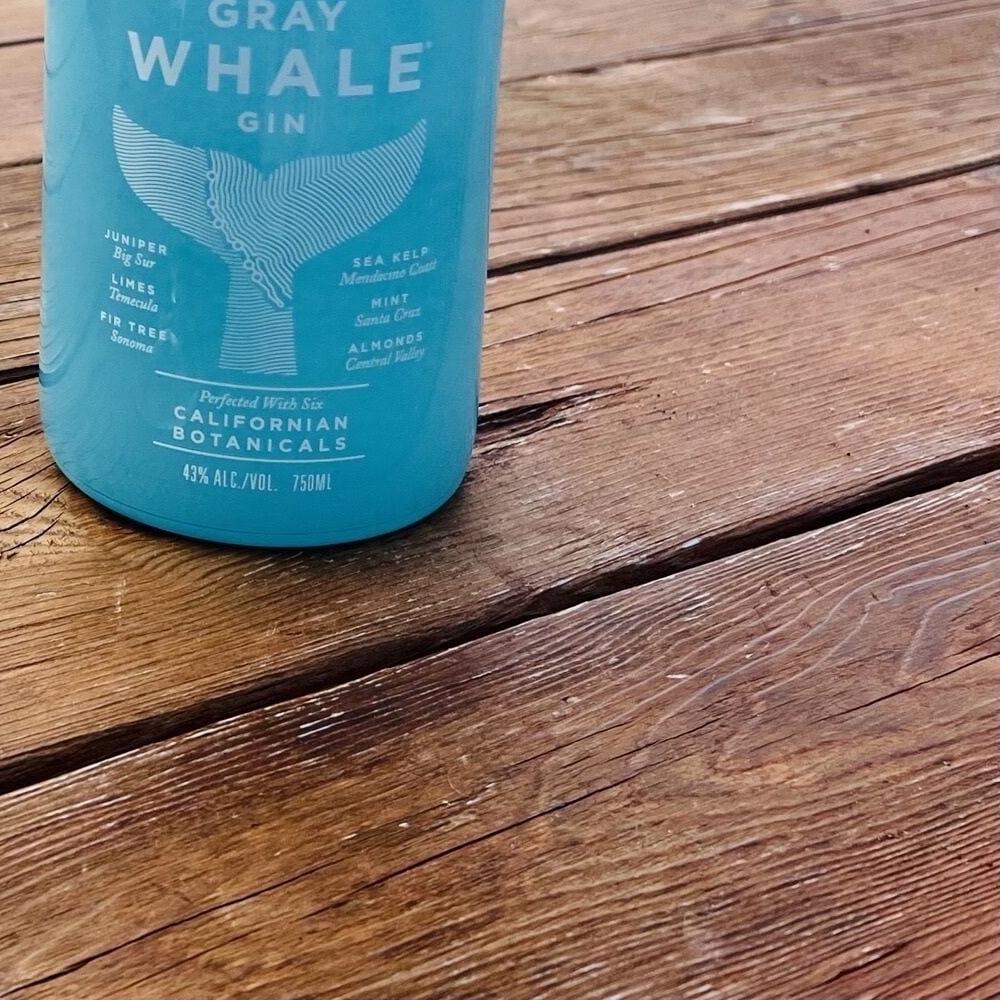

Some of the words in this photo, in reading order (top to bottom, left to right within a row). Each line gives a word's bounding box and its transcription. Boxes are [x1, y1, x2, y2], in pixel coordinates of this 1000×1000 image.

[127, 30, 425, 97] WHALE
[237, 111, 305, 134] GIN
[104, 229, 167, 256] JUNIPER
[113, 245, 132, 267] Big
[135, 253, 156, 269] Sur
[353, 255, 385, 268] SEA
[392, 246, 429, 263] KELP
[111, 273, 155, 295] LIMES
[339, 269, 406, 286] Mendocino
[109, 286, 159, 313] Temecula
[371, 293, 409, 309] MINT
[100, 310, 121, 328] FIR
[128, 321, 168, 341] TREE
[354, 313, 390, 327] Santa
[394, 307, 421, 322] Cruz
[110, 329, 153, 354] Sonoma
[348, 331, 423, 354] ALMONDS
[345, 352, 392, 371] Central
[199, 389, 260, 409] Perfected
[262, 396, 298, 411] With
[300, 396, 325, 411] Six
[173, 406, 349, 432] CALIFORNIAN
[172, 426, 347, 453] BOTANICALS
[182, 463, 209, 485] 43%
[213, 469, 279, 493] ALC./VOL.
[292, 472, 332, 492] 750ML
